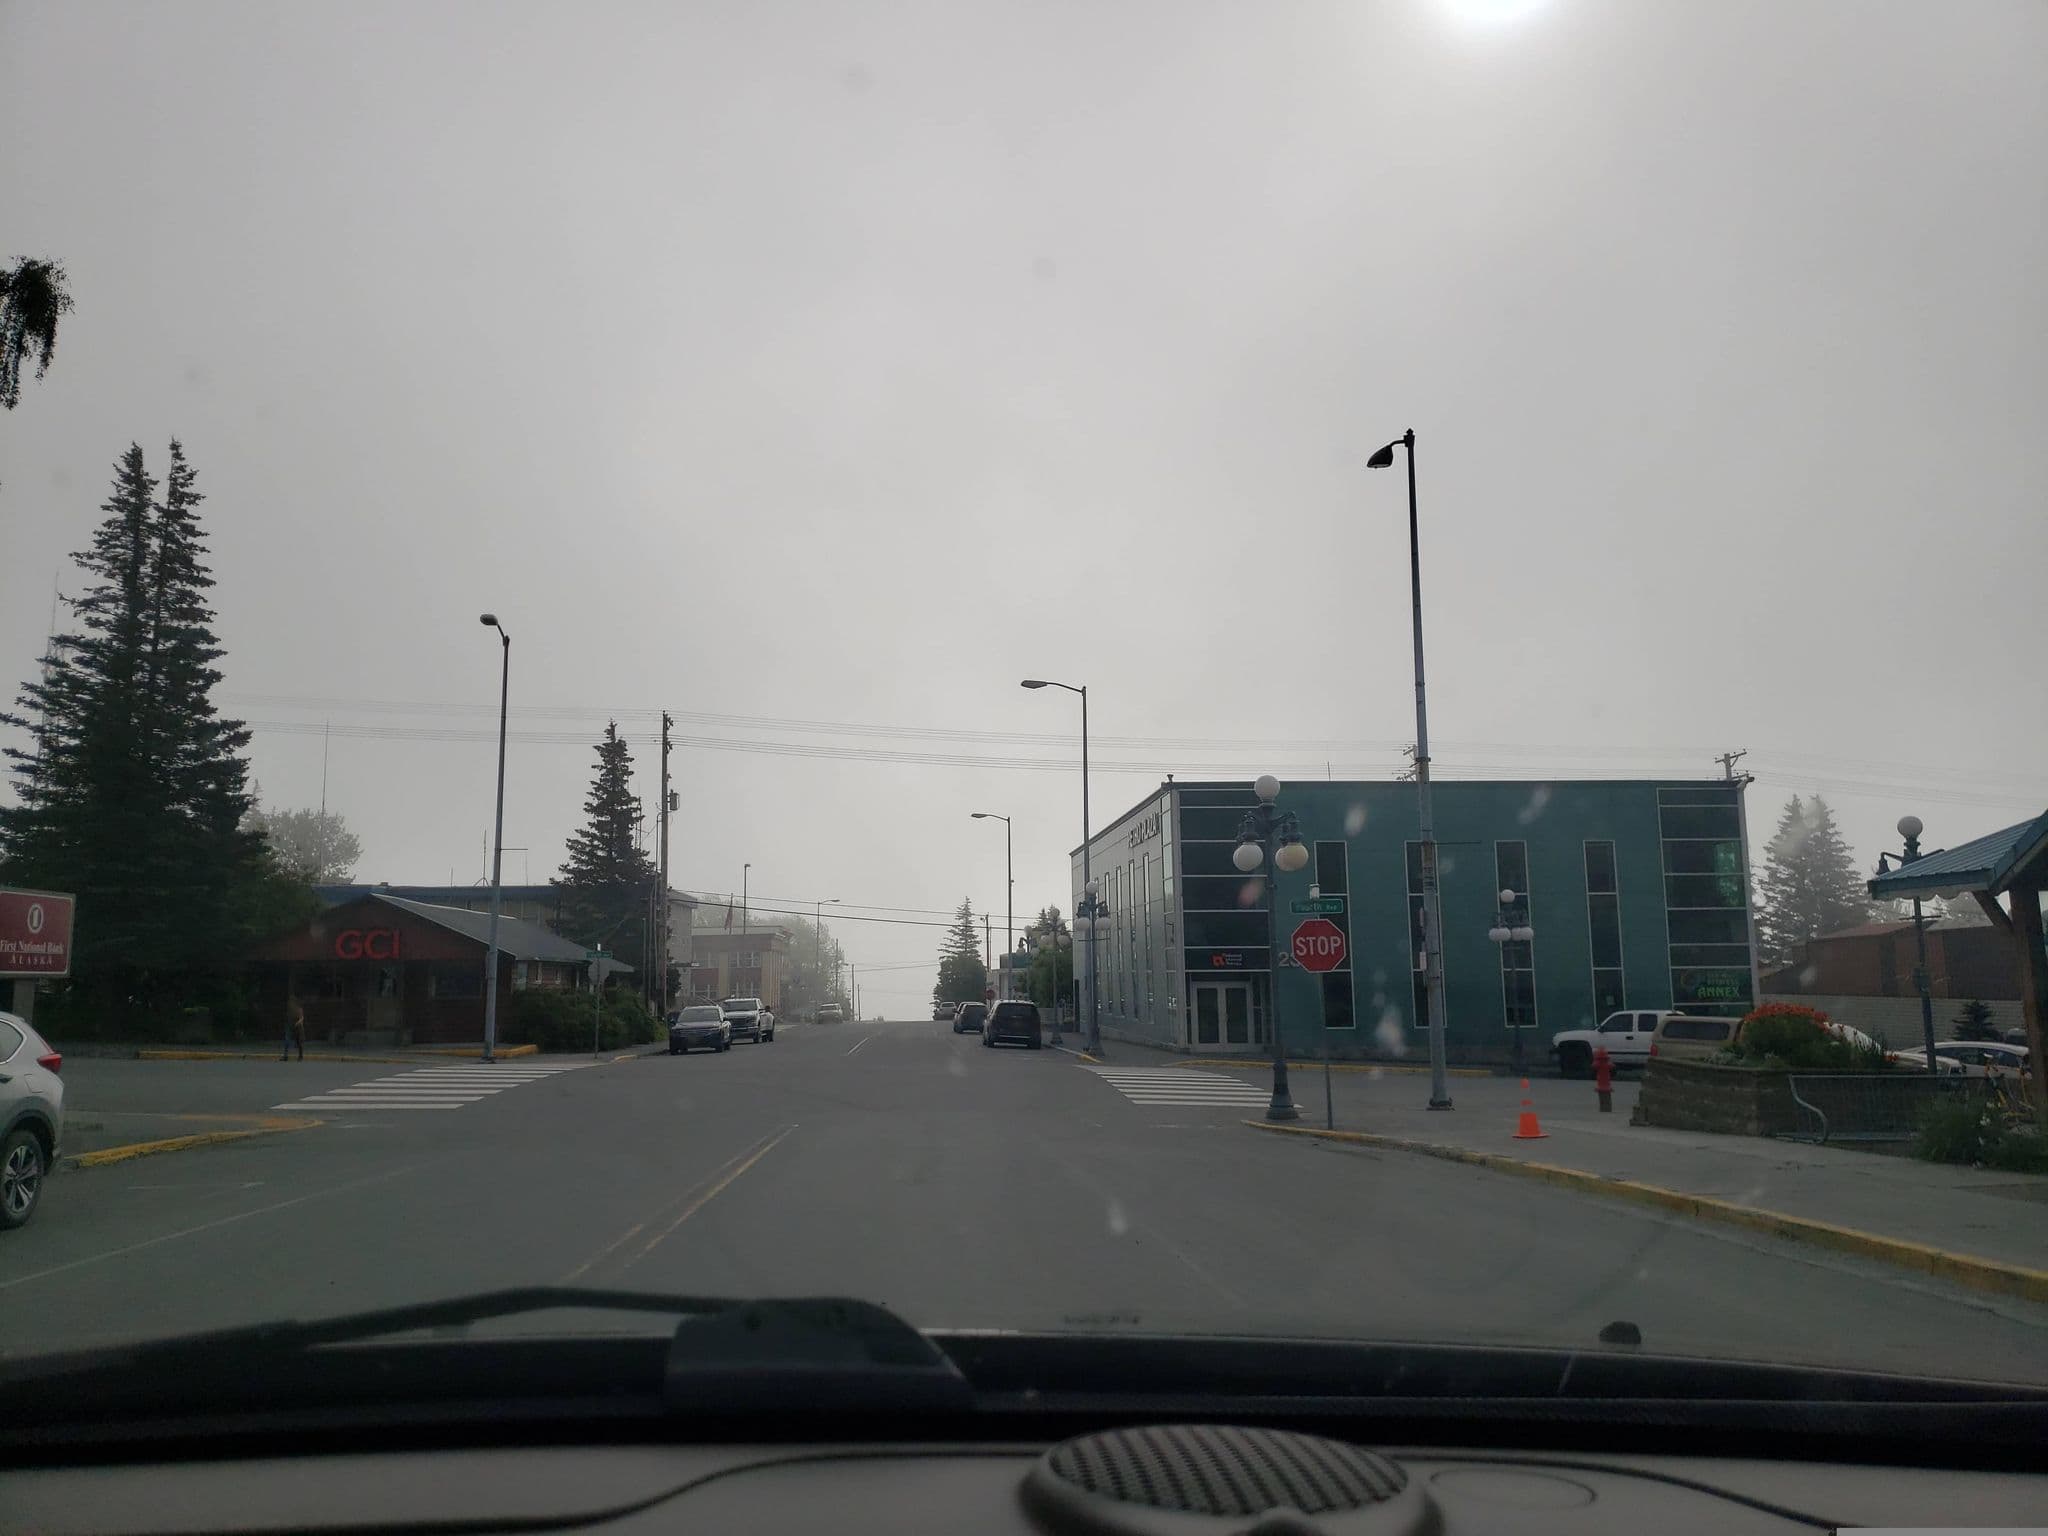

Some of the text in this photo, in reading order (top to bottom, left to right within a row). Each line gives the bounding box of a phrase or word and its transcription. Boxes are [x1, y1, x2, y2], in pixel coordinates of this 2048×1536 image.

[0, 940, 64, 955] First National Bank
[335, 929, 400, 960] GCI
[1295, 936, 1342, 956] STOP
[8, 954, 53, 965] ALASKA
[1697, 985, 1741, 998] ANNEX
